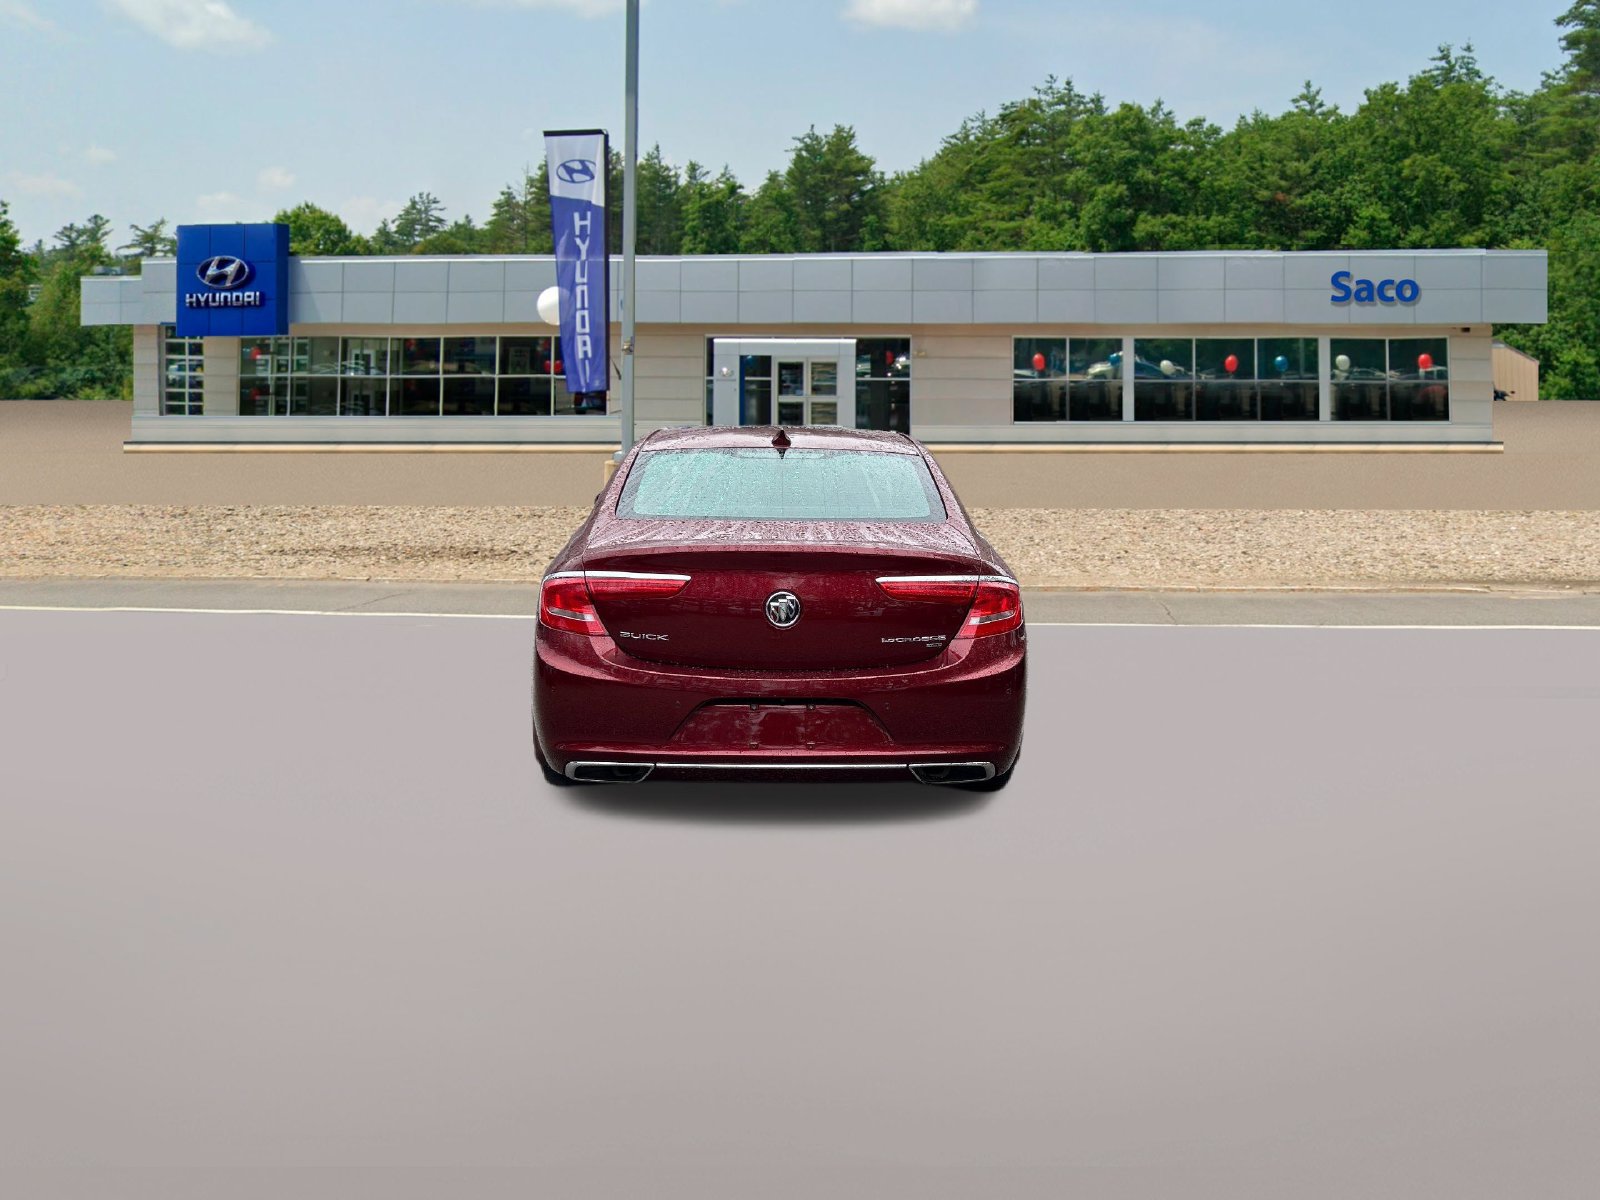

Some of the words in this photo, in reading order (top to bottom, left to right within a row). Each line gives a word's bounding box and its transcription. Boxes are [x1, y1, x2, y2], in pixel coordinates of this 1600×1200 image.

[573, 211, 592, 383] HYUNDAI
[1330, 270, 1420, 303] Saco
[185, 291, 260, 307] HYUNDAI
[620, 631, 669, 641] BUICK
